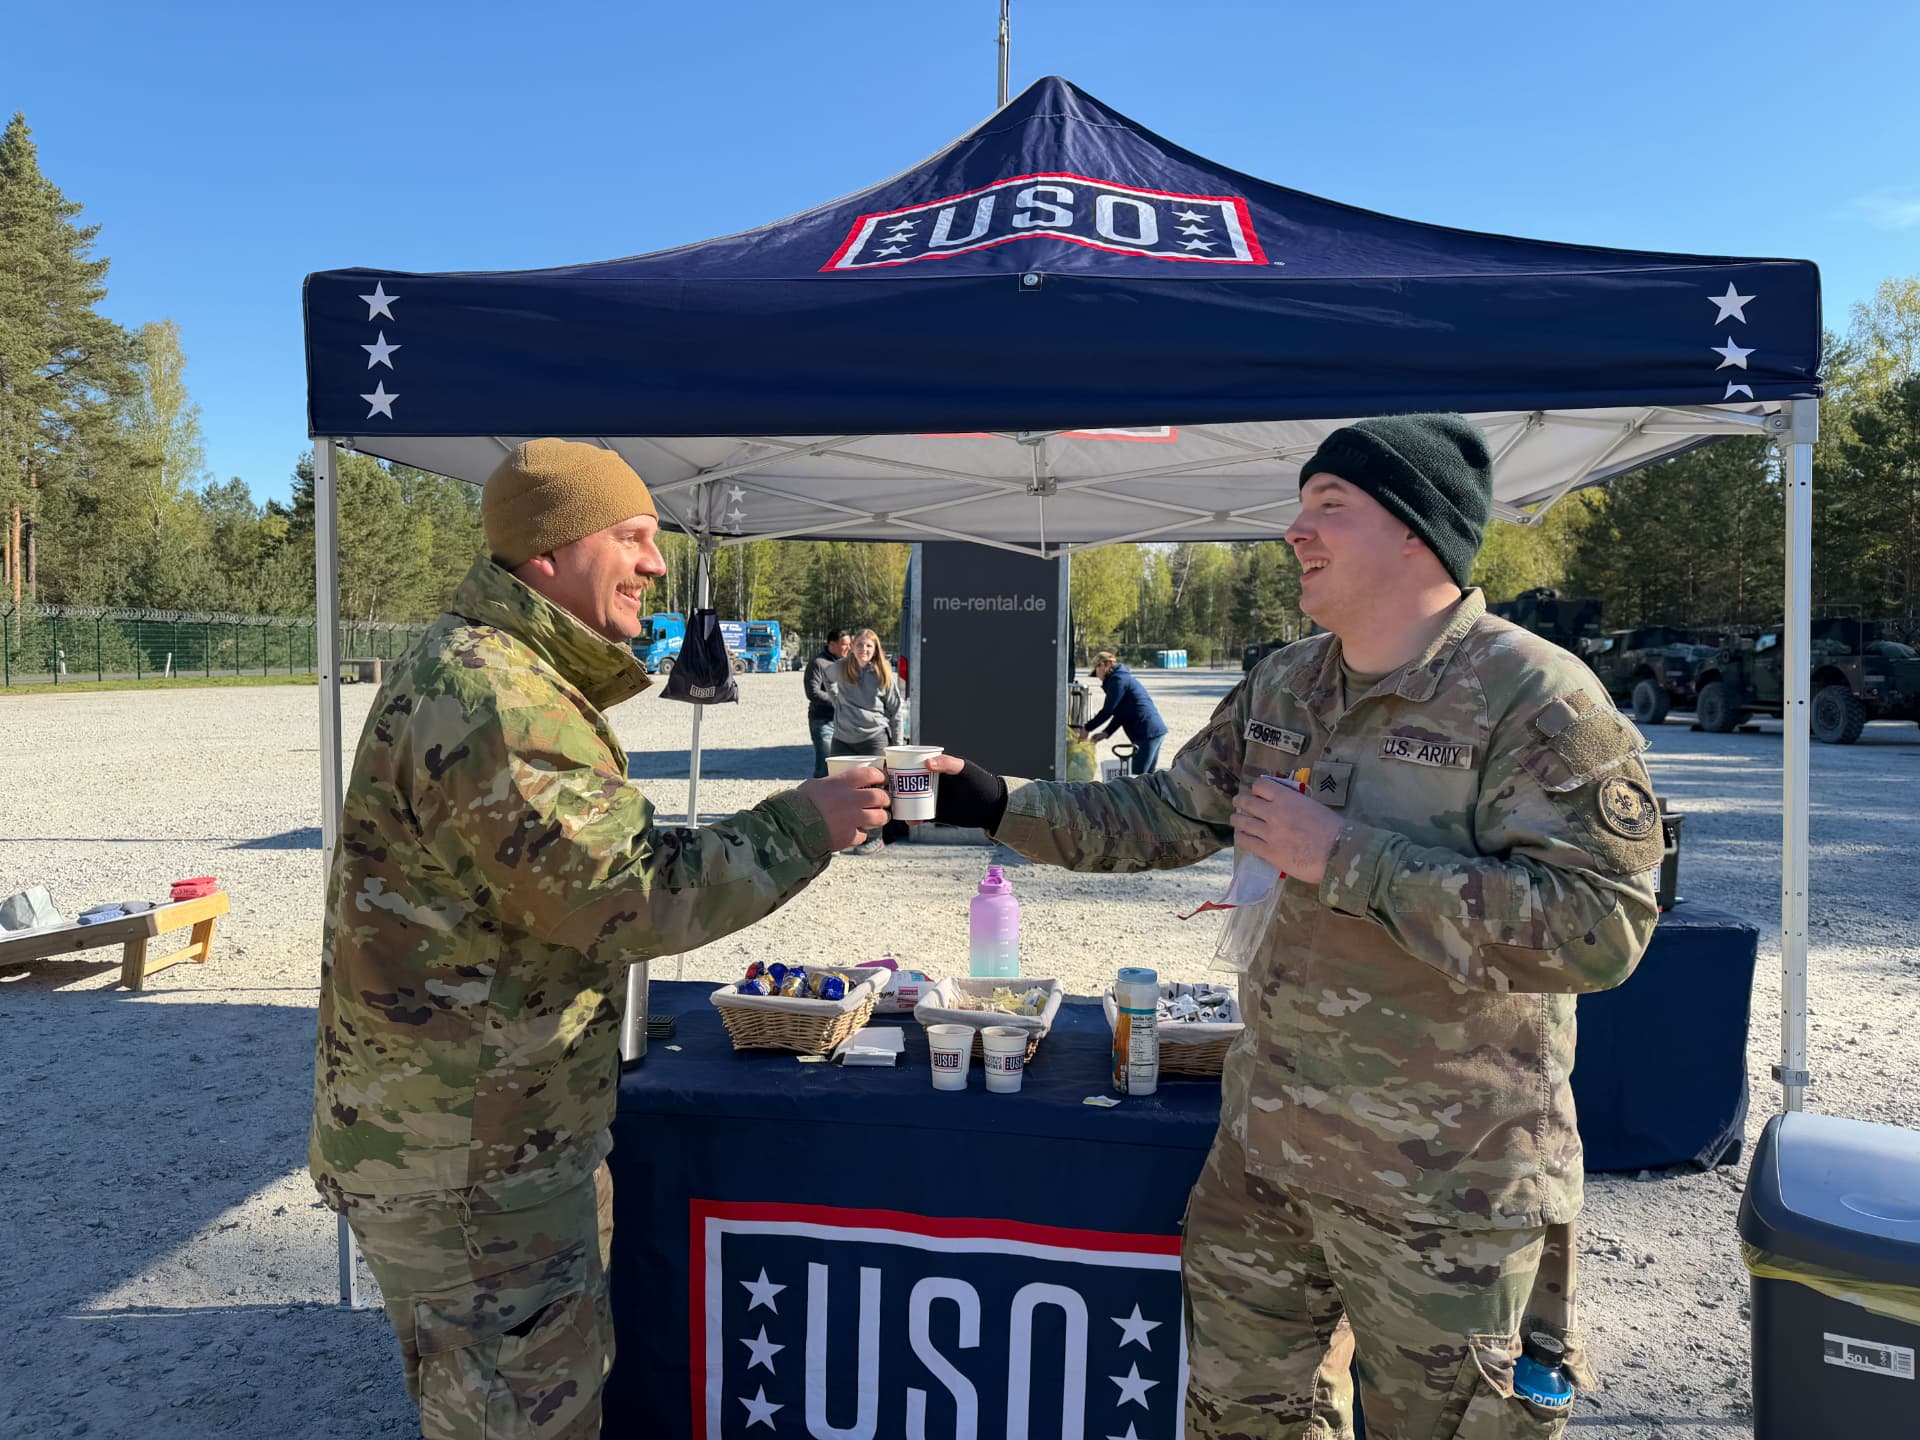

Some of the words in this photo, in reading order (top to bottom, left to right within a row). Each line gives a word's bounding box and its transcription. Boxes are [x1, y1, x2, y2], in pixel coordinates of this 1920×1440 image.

[928, 185, 1159, 248] USO
[933, 594, 1046, 611] me-rental.de
[1384, 739, 1411, 757] U.S.
[902, 775, 925, 792] USO
[937, 1053, 955, 1068] USO
[805, 1262, 1089, 1440] USO
[1847, 1352, 1862, 1365] 50
[1865, 1355, 1874, 1367] L
